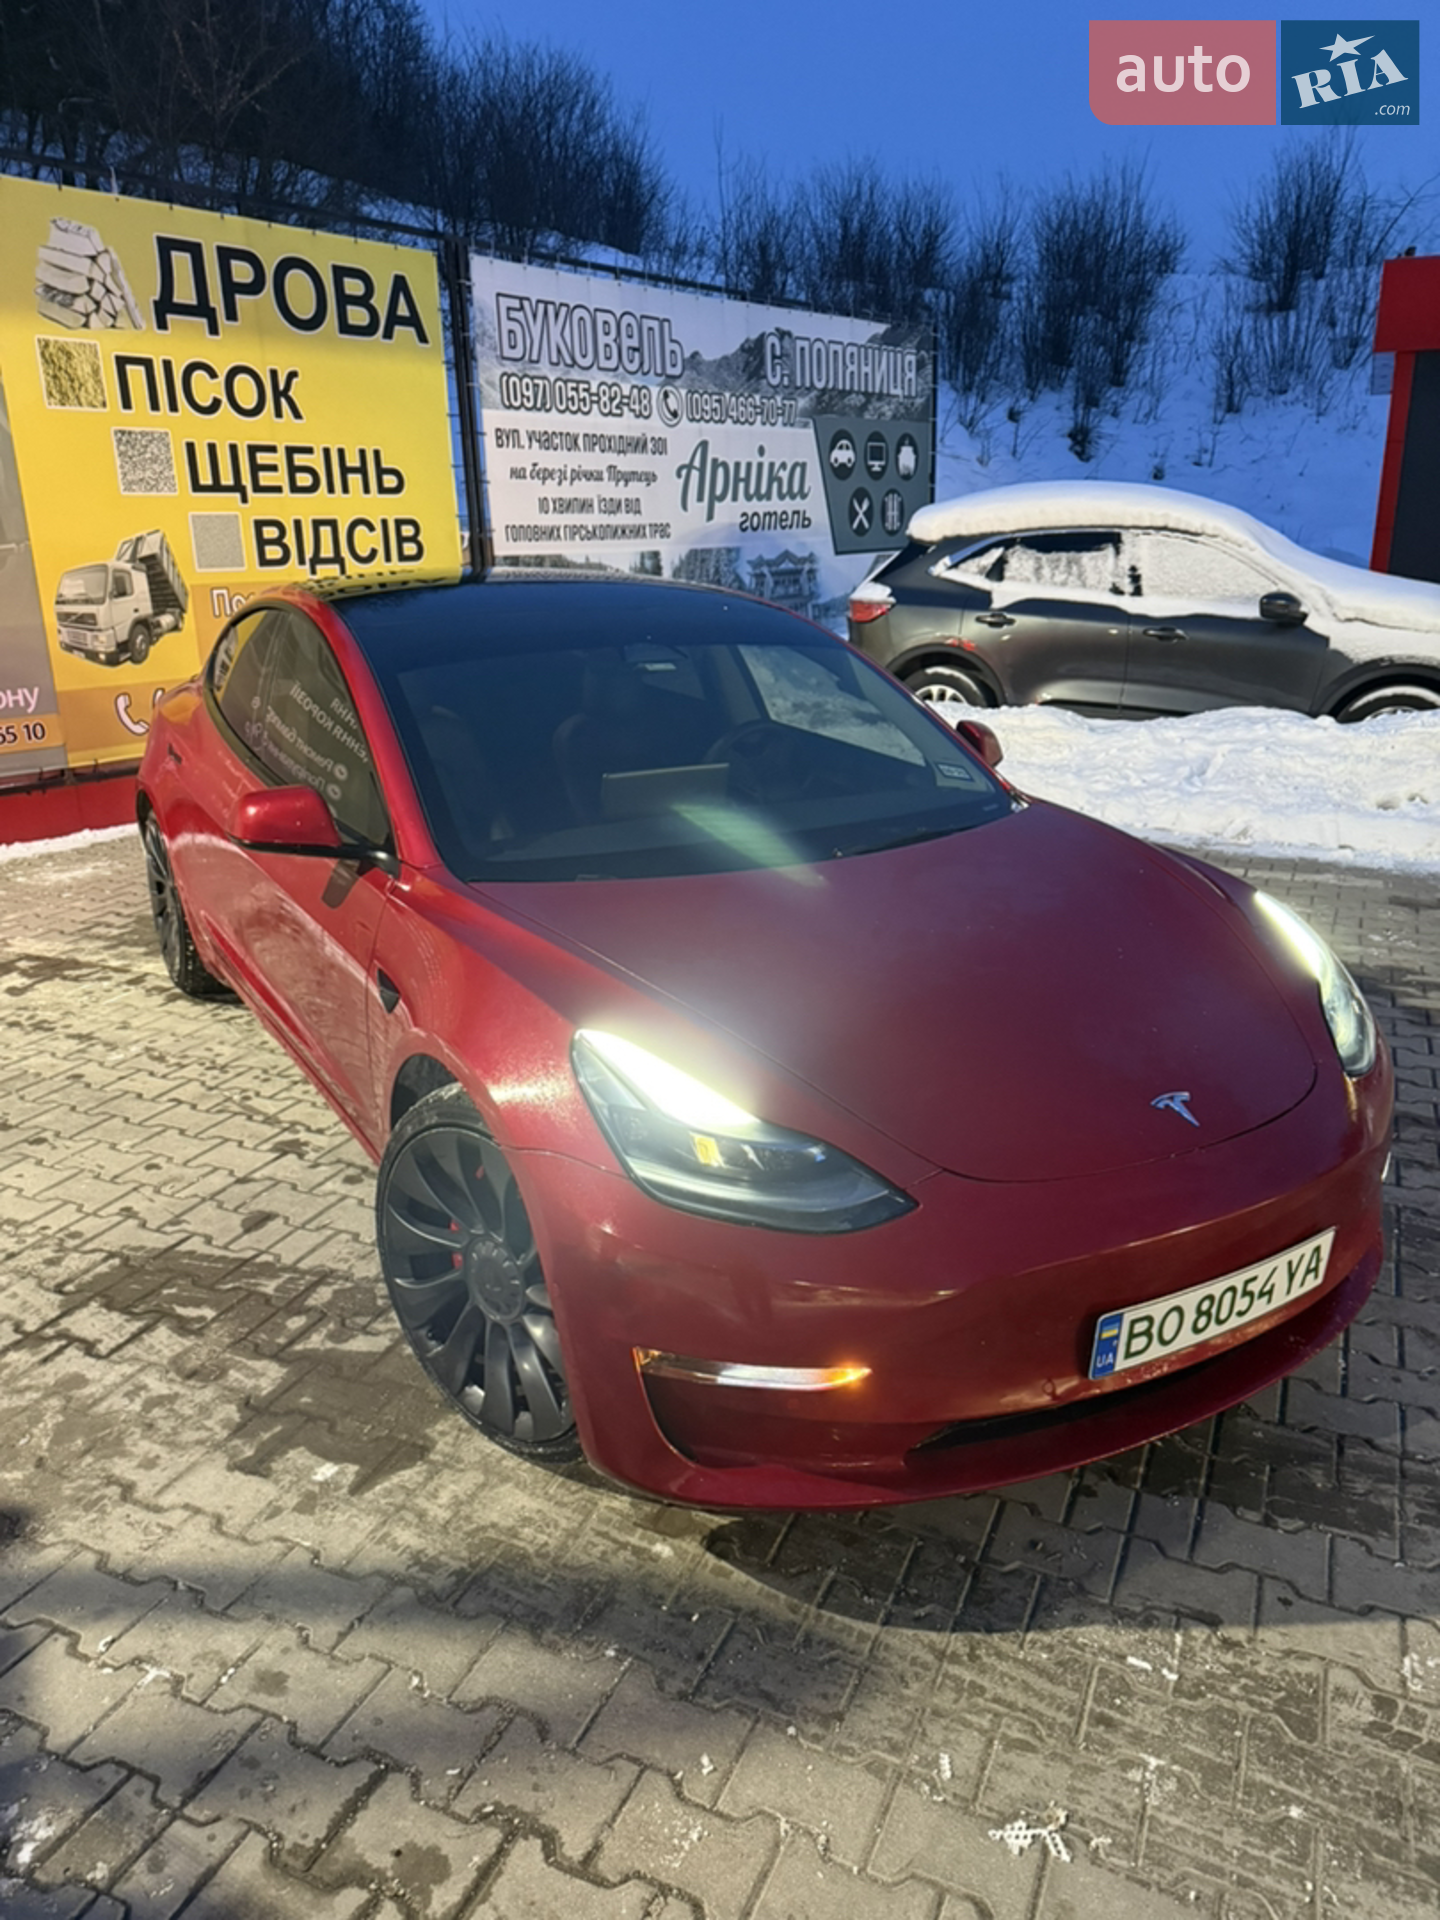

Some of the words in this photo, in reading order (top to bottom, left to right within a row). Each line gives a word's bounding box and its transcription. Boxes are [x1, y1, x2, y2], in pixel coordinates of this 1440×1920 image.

[153, 233, 430, 345] ДРОВА
[113, 354, 304, 421] ПІСОК
[794, 336, 917, 400] ПОЛЯНИЦЯ
[500, 373, 551, 412] (097)
[553, 378, 652, 419] 055-82-48
[686, 389, 727, 423] (095)
[727, 391, 798, 425] 466-70-77
[582, 433, 648, 456] ПРОХІДНИЙ
[184, 440, 406, 504] ЩЕБІНЬ
[509, 466, 527, 480] на
[529, 462, 568, 486] березі
[569, 464, 604, 486] річки
[675, 438, 811, 523] Арніка
[551, 497, 594, 515] ХВИЛИН
[597, 494, 623, 516] ЇЗДИ
[624, 497, 642, 516] ВІД
[739, 508, 812, 533] готель
[252, 517, 425, 575] ВІДСІВ
[505, 523, 562, 543] ГОЛОВНИХ
[22, 721, 46, 741] 10
[1123, 1304, 1185, 1361] BO
[1191, 1266, 1278, 1335] 8054
[1285, 1244, 1323, 1296] YA
[1097, 1352, 1114, 1367] UA
